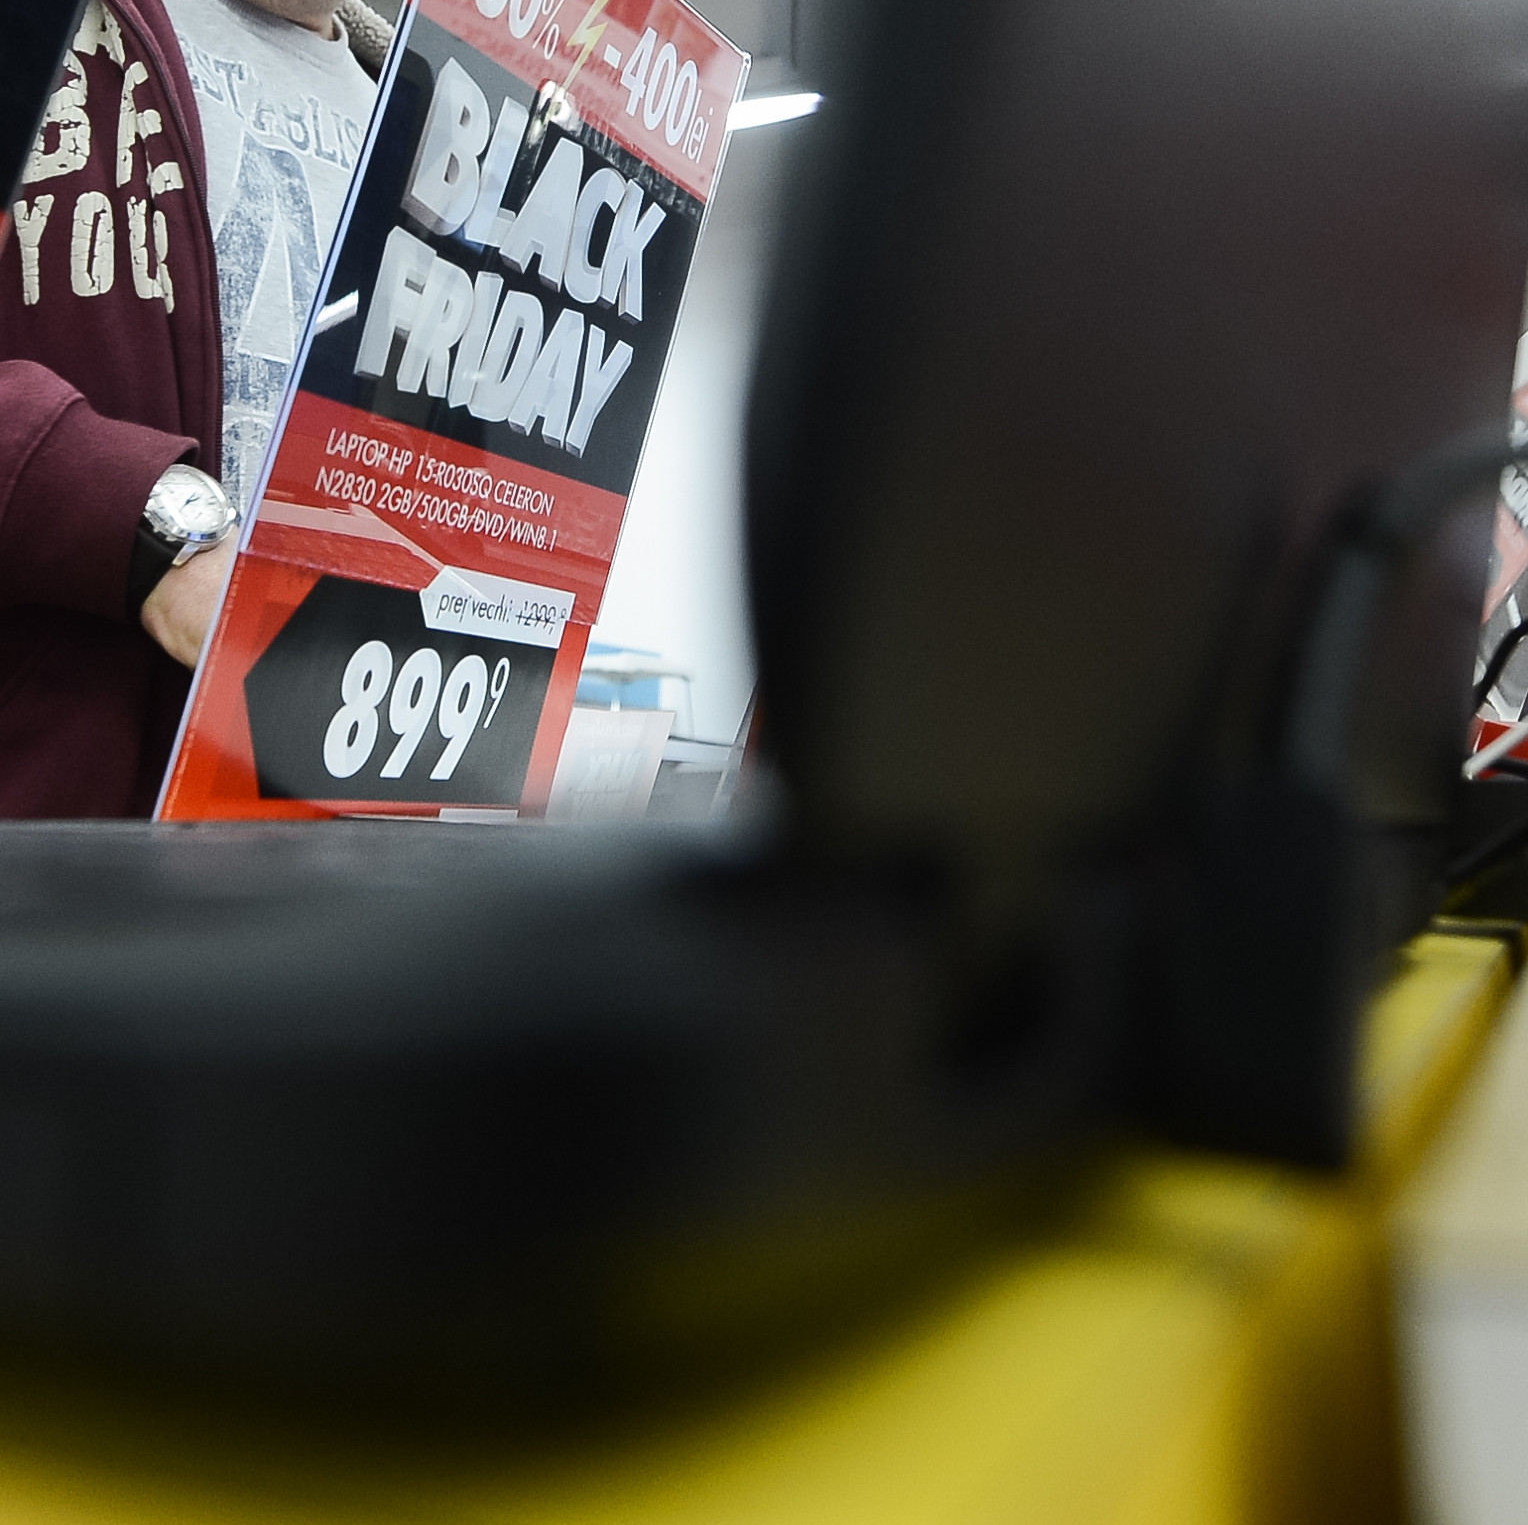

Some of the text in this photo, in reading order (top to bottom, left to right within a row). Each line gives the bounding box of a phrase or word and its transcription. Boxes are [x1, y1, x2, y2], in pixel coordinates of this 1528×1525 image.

[12, 190, 176, 315] YOU
[402, 57, 667, 324] BLACK
[354, 225, 635, 458] FRIDAY
[315, 465, 376, 508] N2830
[324, 427, 390, 470] LAPTOP
[493, 477, 555, 518] CELERON
